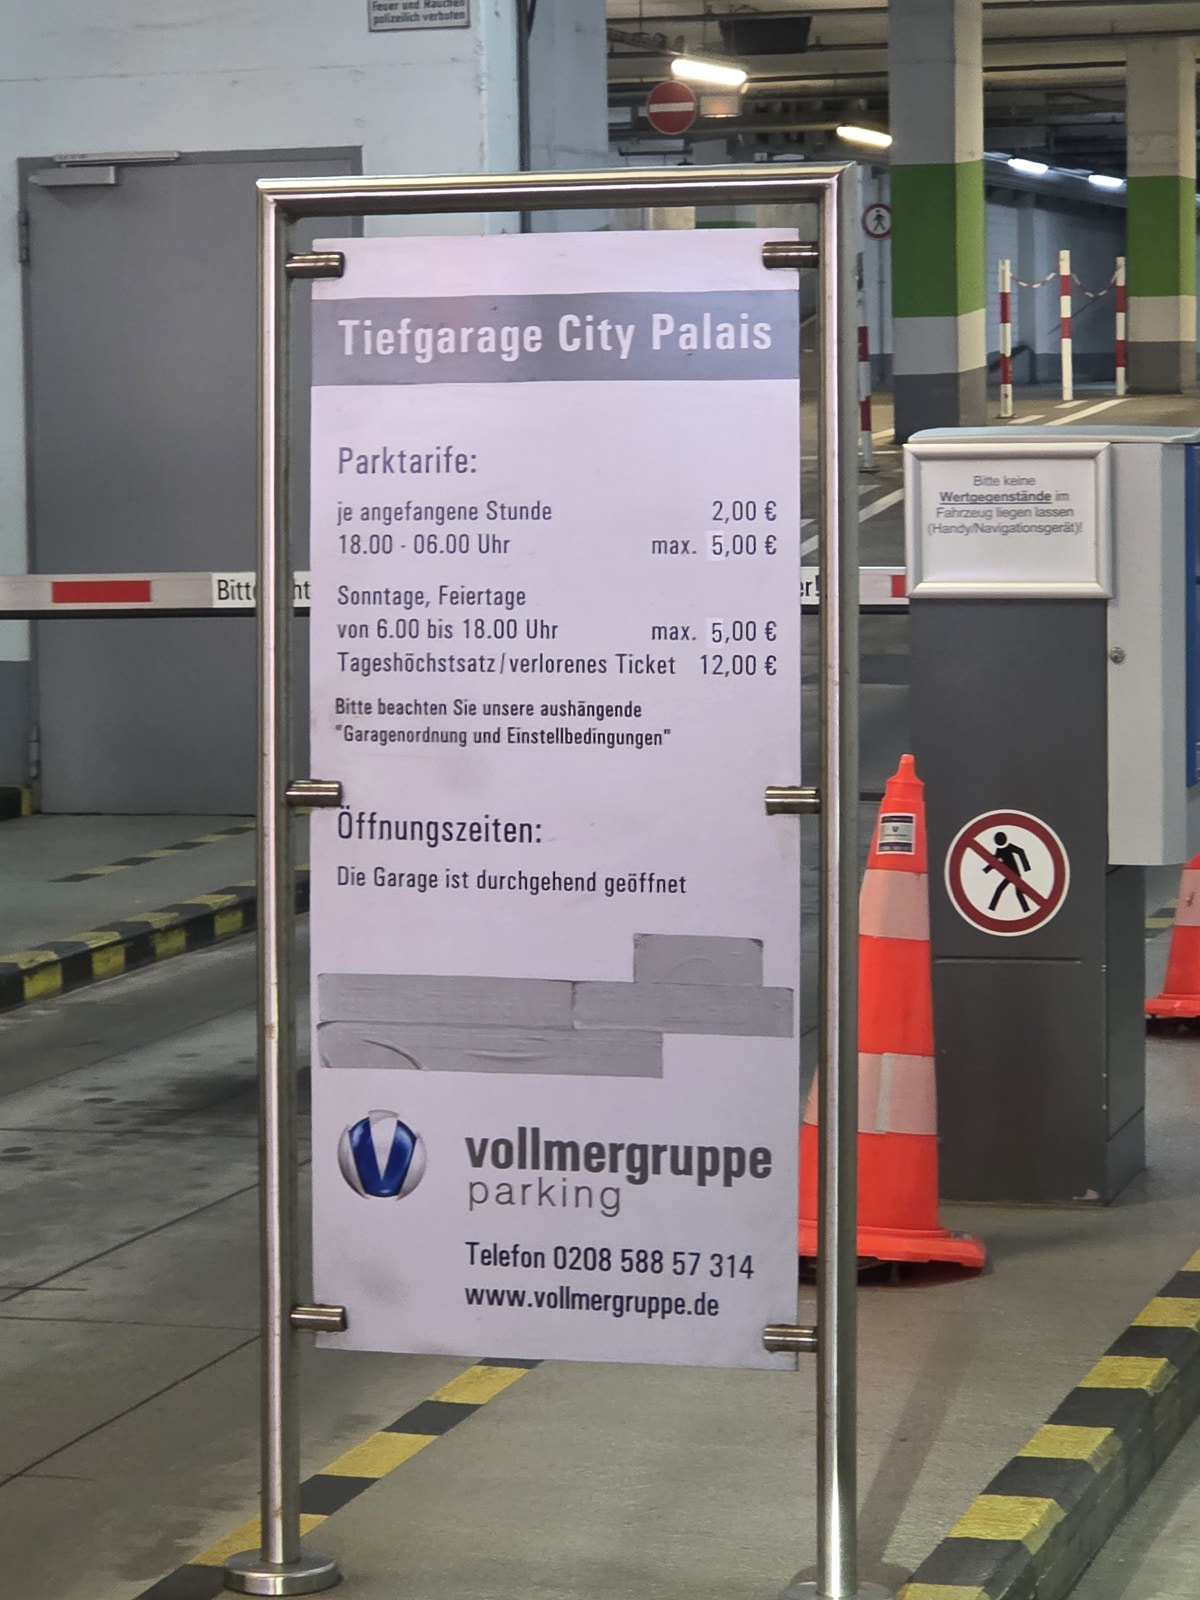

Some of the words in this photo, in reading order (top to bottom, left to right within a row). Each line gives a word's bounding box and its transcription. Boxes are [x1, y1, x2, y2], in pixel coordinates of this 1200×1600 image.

[423, 11, 465, 20] verboten
[338, 318, 542, 363] Tiefgarage
[559, 314, 635, 359] City
[652, 313, 771, 350] Palais
[339, 446, 476, 474] Parktarife:
[974, 476, 999, 486] Bitte
[1004, 475, 1036, 486] keine
[940, 491, 1052, 504] Wertgegenstände
[1055, 490, 1069, 501] im
[337, 502, 352, 526] je
[361, 501, 478, 526] angefangene
[486, 501, 551, 520] Stunde
[713, 501, 756, 524] 2,00
[765, 501, 776, 521] €
[936, 507, 992, 519] Fahrzeug
[996, 507, 1031, 519] liegen
[1035, 507, 1073, 517] lassen
[928, 522, 1082, 536] (Handy/Navigationsgerät)!
[340, 534, 392, 554] 18.00
[414, 534, 469, 554] 06.00
[478, 534, 510, 554] Uhr
[652, 540, 696, 554] max.
[713, 535, 756, 557] 5,00
[765, 535, 776, 555] €
[338, 585, 430, 610] Sonntage,
[439, 585, 525, 610] Feiertage
[338, 624, 368, 638] von
[377, 619, 419, 638] 6.00
[428, 619, 453, 639] bis
[464, 619, 517, 639] 18.00
[527, 619, 558, 639] Uhr
[652, 626, 696, 640] max.
[712, 621, 756, 643] 5,00
[765, 621, 776, 641] €
[615, 654, 675, 674] Ticket
[701, 655, 756, 677] 12,00
[764, 655, 776, 675] €
[336, 698, 372, 715] Bitte
[378, 698, 447, 715] beachten
[453, 699, 476, 716] Sie
[483, 704, 534, 716] unsere
[541, 700, 641, 721] aushängende
[336, 725, 467, 747] "Garagenordnung
[474, 727, 500, 743] und
[508, 727, 670, 749] Einstellbedingungen"
[338, 805, 541, 848] Öffnungszeiten:
[338, 866, 365, 886] Die
[374, 867, 438, 893] Garage
[446, 869, 468, 888] ist
[477, 869, 596, 895] durchgehend
[605, 873, 686, 897] geöffnet
[465, 1127, 771, 1189] vollmergruppe
[469, 1177, 620, 1217] parking
[465, 1242, 545, 1268] Telefon
[554, 1246, 611, 1271] 0208
[621, 1249, 663, 1274] 588
[673, 1252, 700, 1275] 57
[710, 1253, 754, 1279] 314
[465, 1286, 718, 1319] www.vollmergruppe.de
